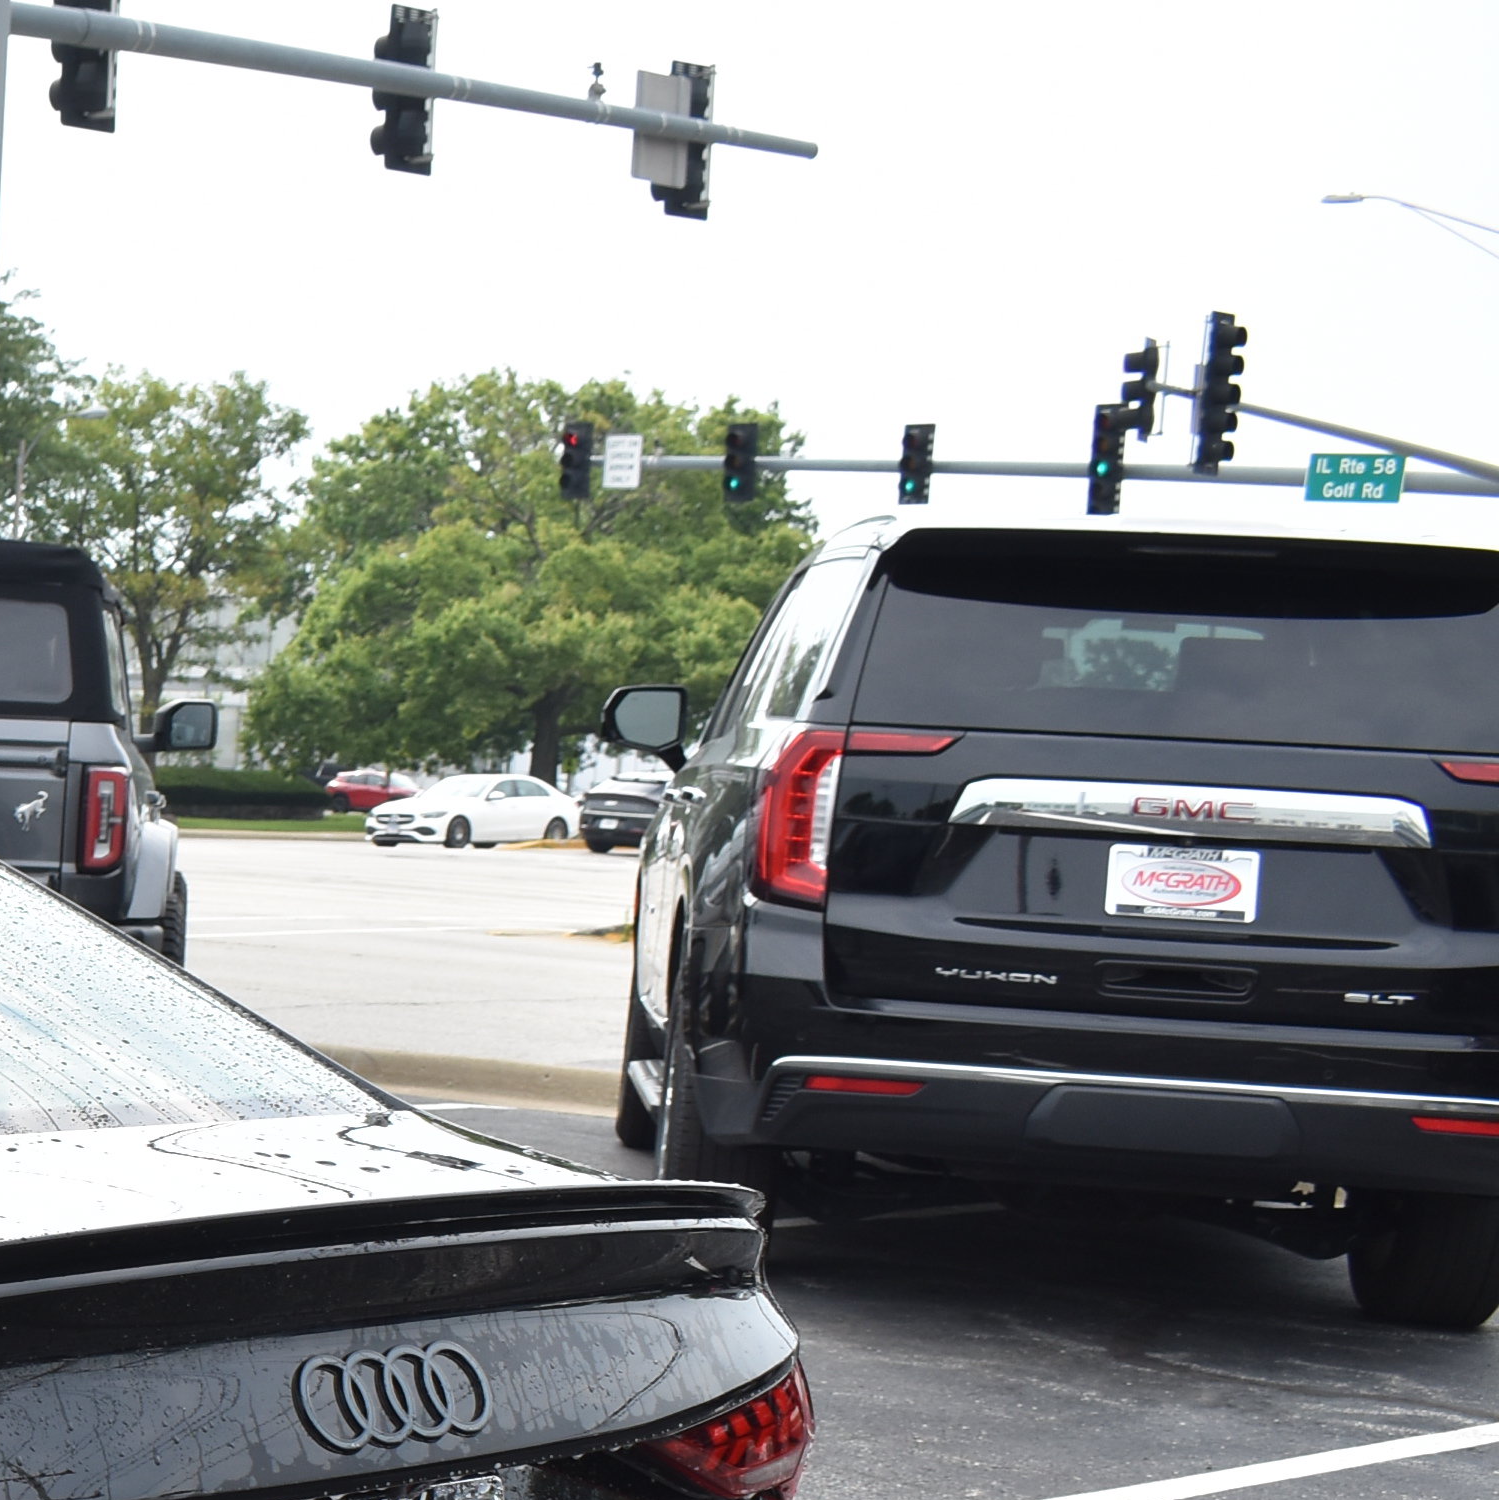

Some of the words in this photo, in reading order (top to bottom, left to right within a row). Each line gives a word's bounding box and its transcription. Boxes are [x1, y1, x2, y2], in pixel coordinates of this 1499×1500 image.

[1315, 458, 1332, 474] IL
[1339, 458, 1366, 475] Rte
[1373, 458, 1397, 475] 58
[1322, 481, 1356, 498] Golf
[1361, 482, 1385, 499] Rd
[1132, 796, 1255, 823] GMC
[935, 967, 1058, 984] YUKON
[1344, 992, 1416, 1006] SLT
